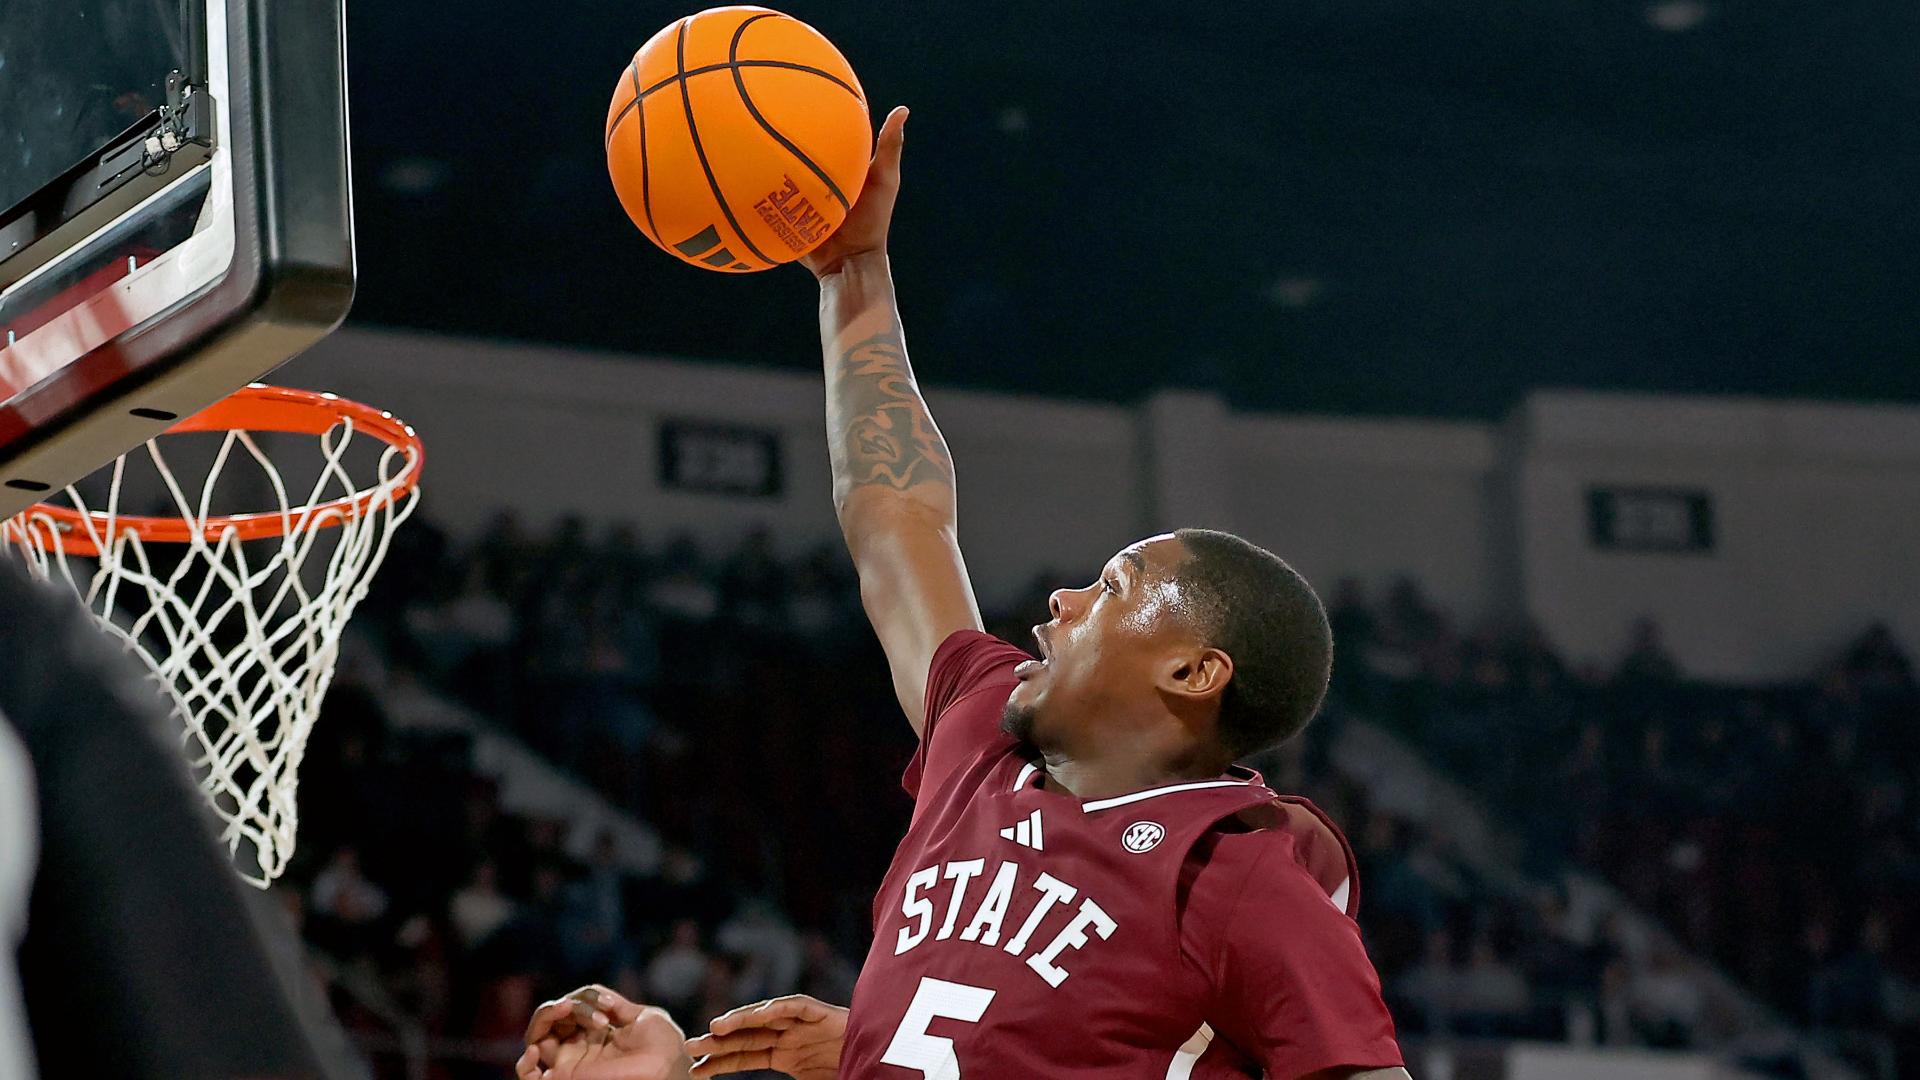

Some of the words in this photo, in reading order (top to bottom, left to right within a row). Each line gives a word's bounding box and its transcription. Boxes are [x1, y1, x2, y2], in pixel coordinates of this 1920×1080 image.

[768, 177, 831, 244] STATE
[1123, 822, 1164, 852] SEC
[894, 858, 1119, 989] STATE
[879, 976, 997, 1080] 5
